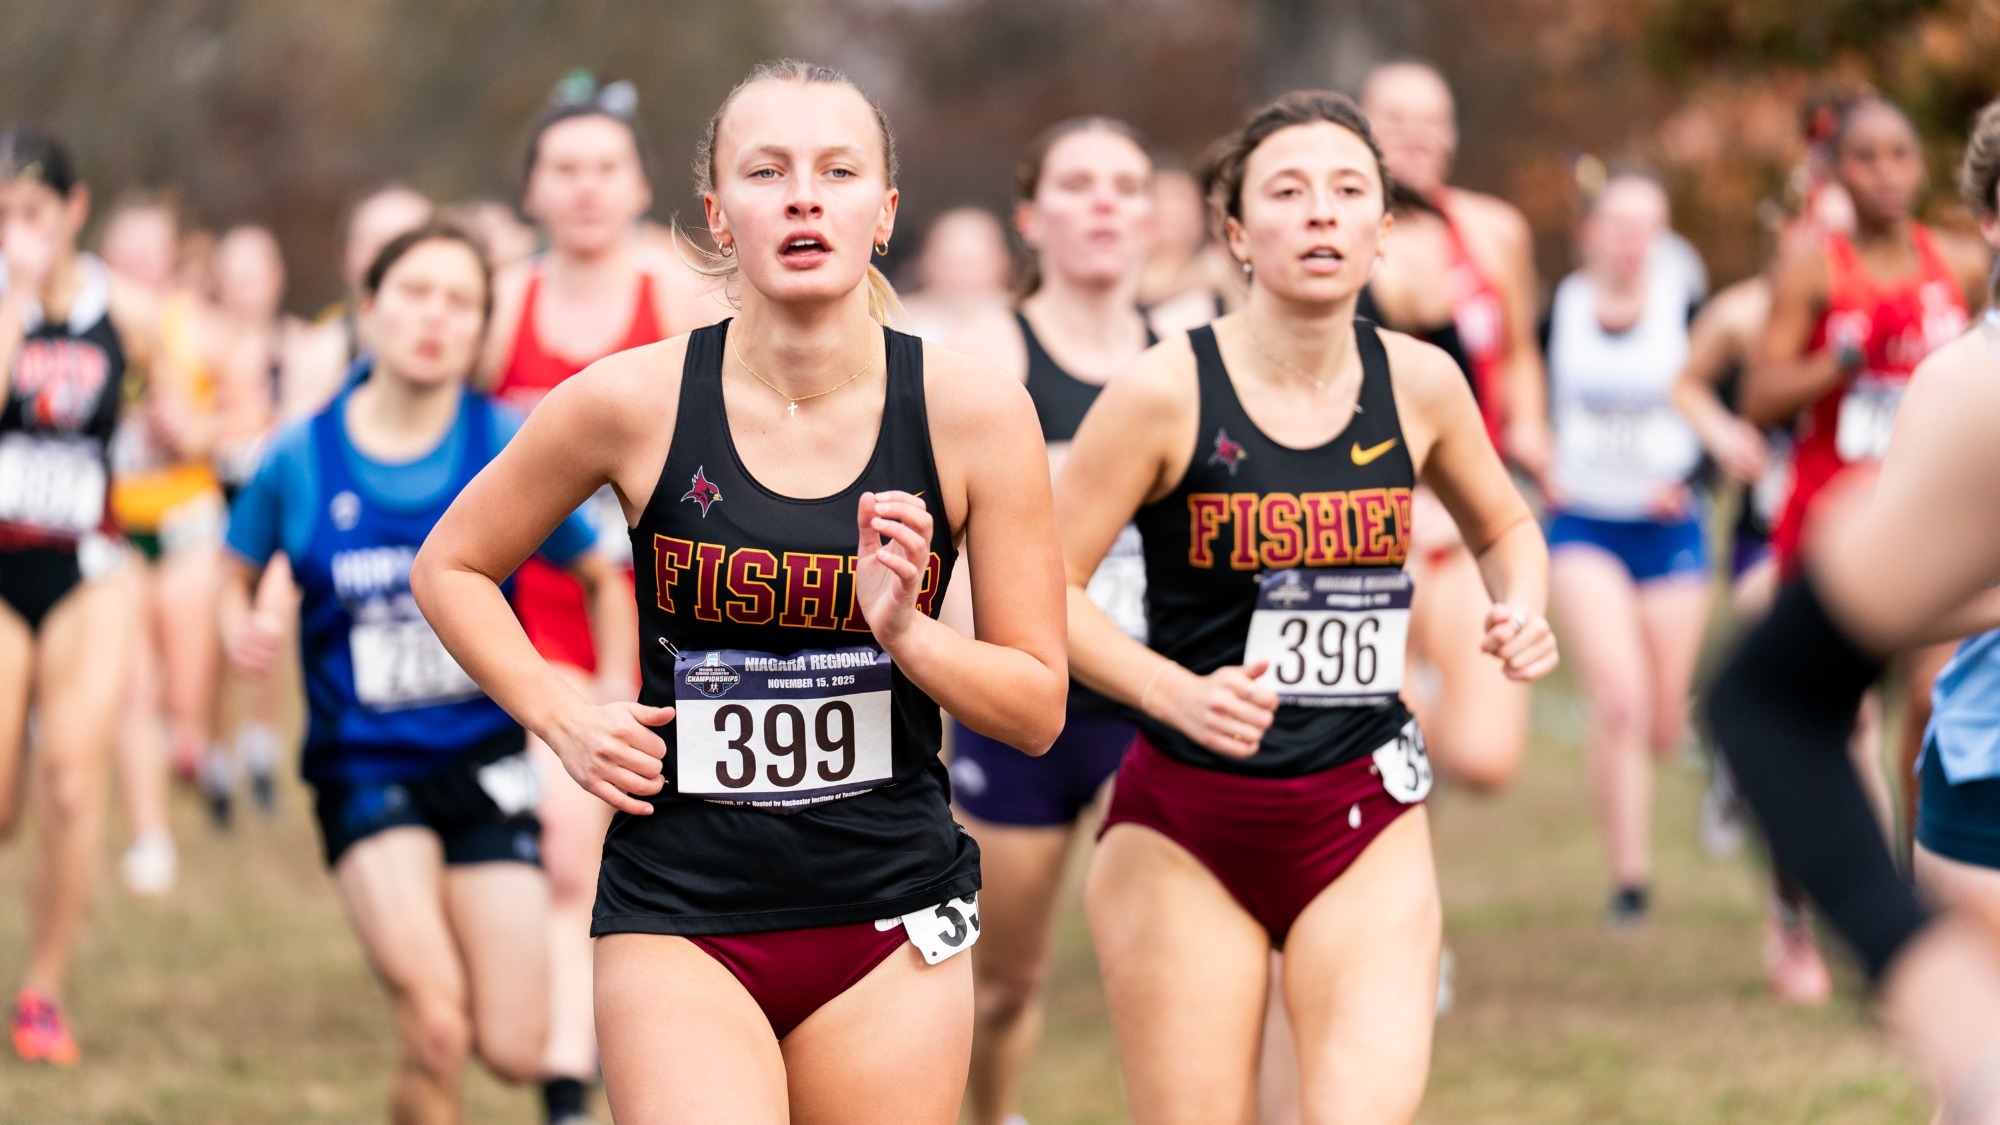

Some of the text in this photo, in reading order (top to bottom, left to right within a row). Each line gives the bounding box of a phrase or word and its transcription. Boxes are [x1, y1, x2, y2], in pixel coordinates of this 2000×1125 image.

[1276, 617, 1380, 686] 396
[745, 652, 877, 672] NIAGARA REGIONAL
[687, 675, 739, 683] CHAMPIONSHIPS
[767, 674, 856, 689] NOVEMBER 15, 2025
[713, 700, 856, 789] 399
[781, 798, 811, 807] Rochester
[811, 794, 834, 804] Institute
